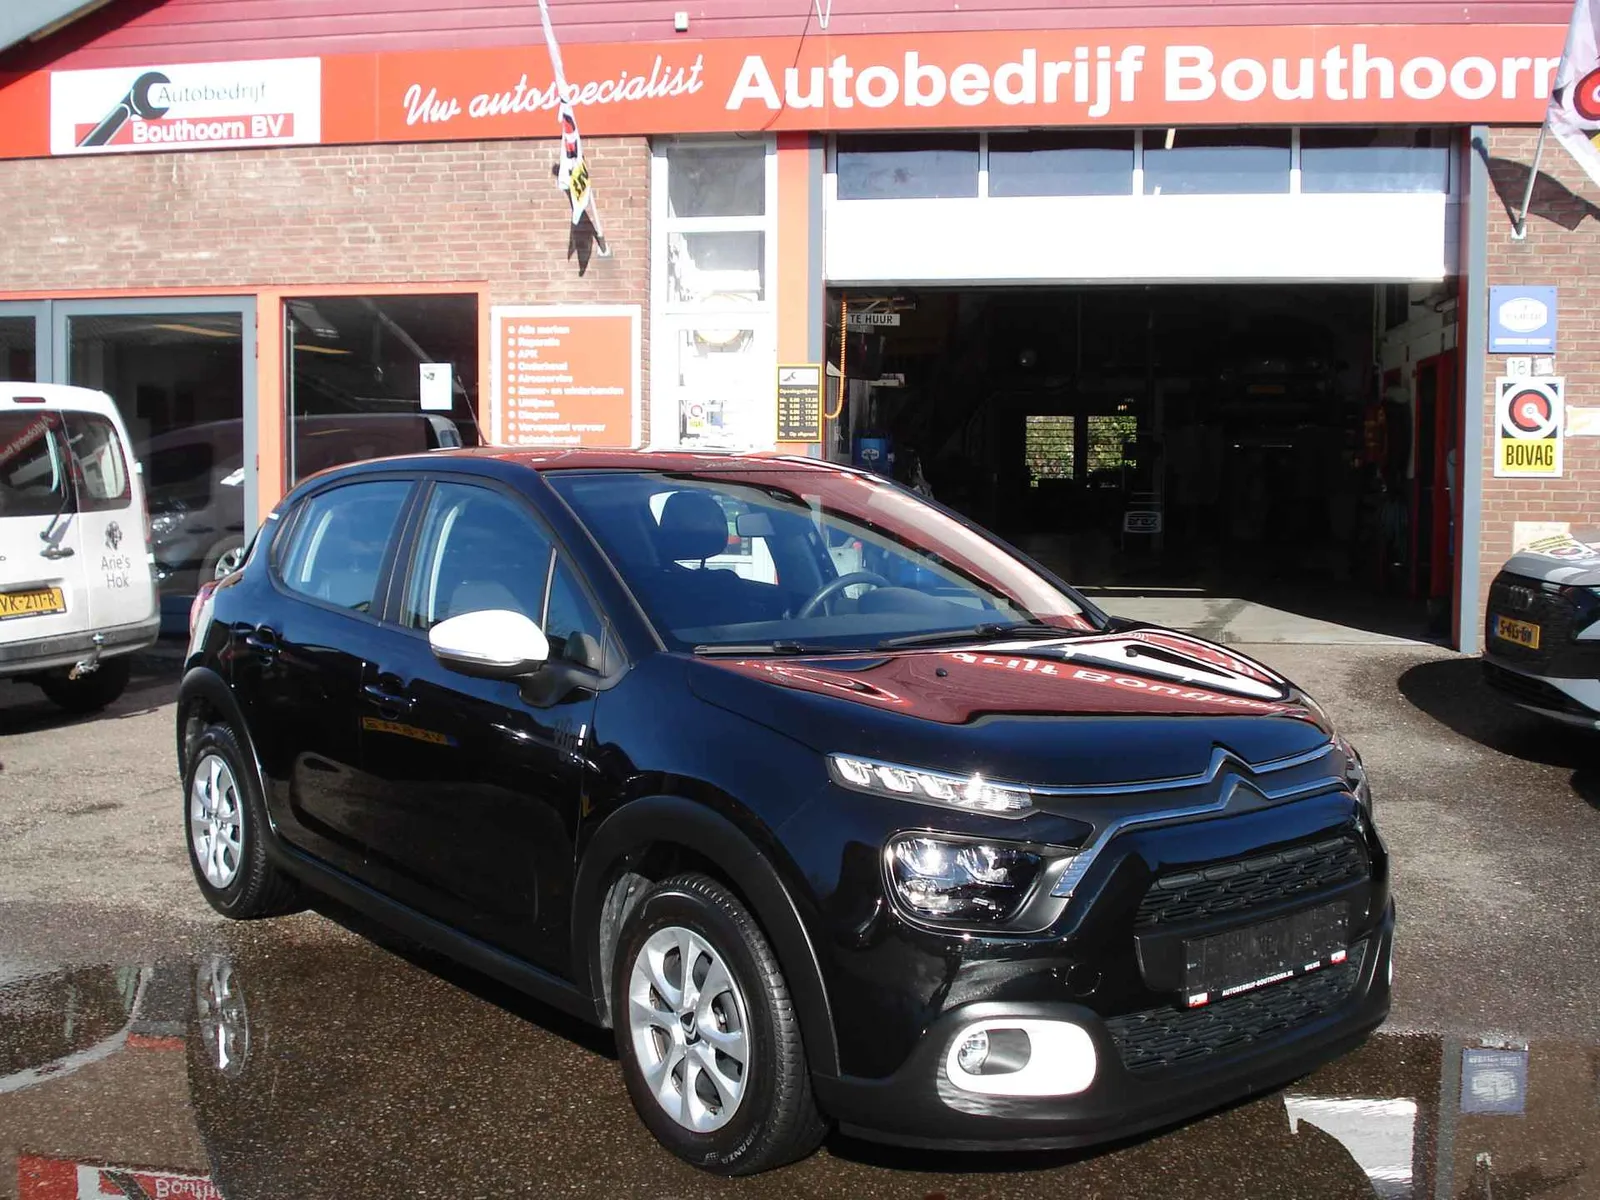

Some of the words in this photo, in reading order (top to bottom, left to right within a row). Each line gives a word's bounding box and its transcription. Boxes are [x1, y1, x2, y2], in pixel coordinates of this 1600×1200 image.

[158, 81, 267, 104] Autobedrijf
[403, 84, 461, 126] Uw
[469, 54, 704, 121] autospecialist
[725, 45, 1146, 118] Autobedrijf
[132, 119, 245, 144] Bouthoorn
[251, 114, 285, 137] BV
[850, 314, 861, 324] TE
[865, 314, 893, 324] HUUR
[1511, 360, 1527, 375] 18
[1506, 444, 1553, 467] BOVAG
[101, 554, 131, 570] Arie's
[106, 572, 130, 589] Hok
